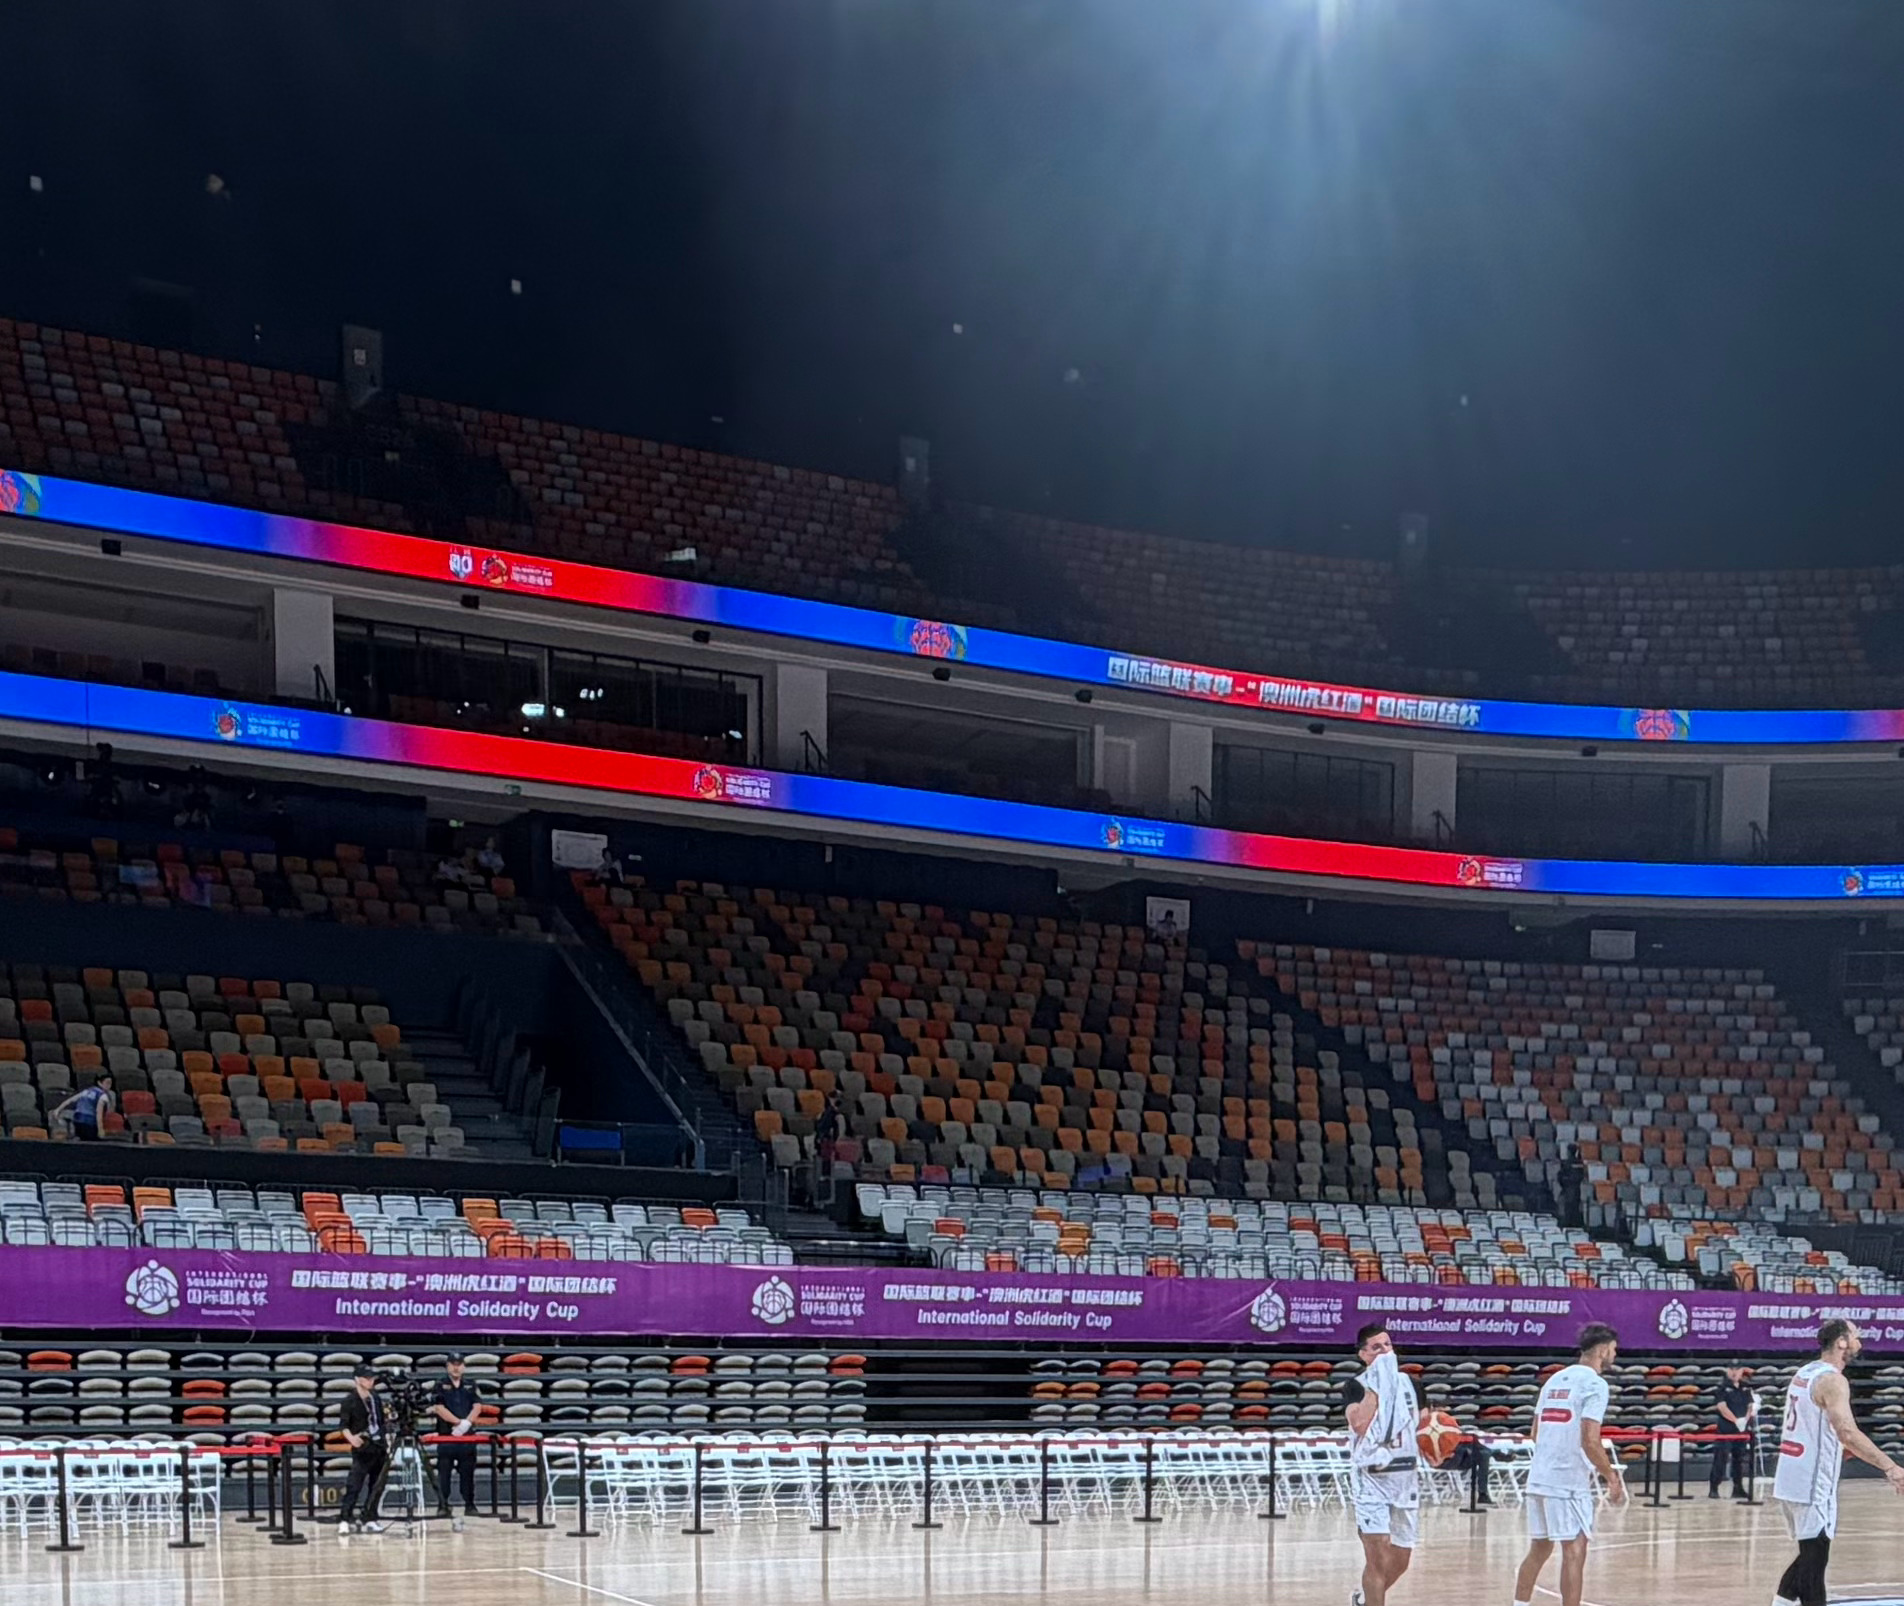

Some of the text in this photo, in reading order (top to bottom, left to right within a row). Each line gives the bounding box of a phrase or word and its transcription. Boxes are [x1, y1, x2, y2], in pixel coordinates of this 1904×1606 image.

[335, 1297, 579, 1322] International Solidarity Cup
[917, 1308, 1113, 1330] International Solidarity Cup
[1385, 1316, 1546, 1336] International Solidarity Cup
